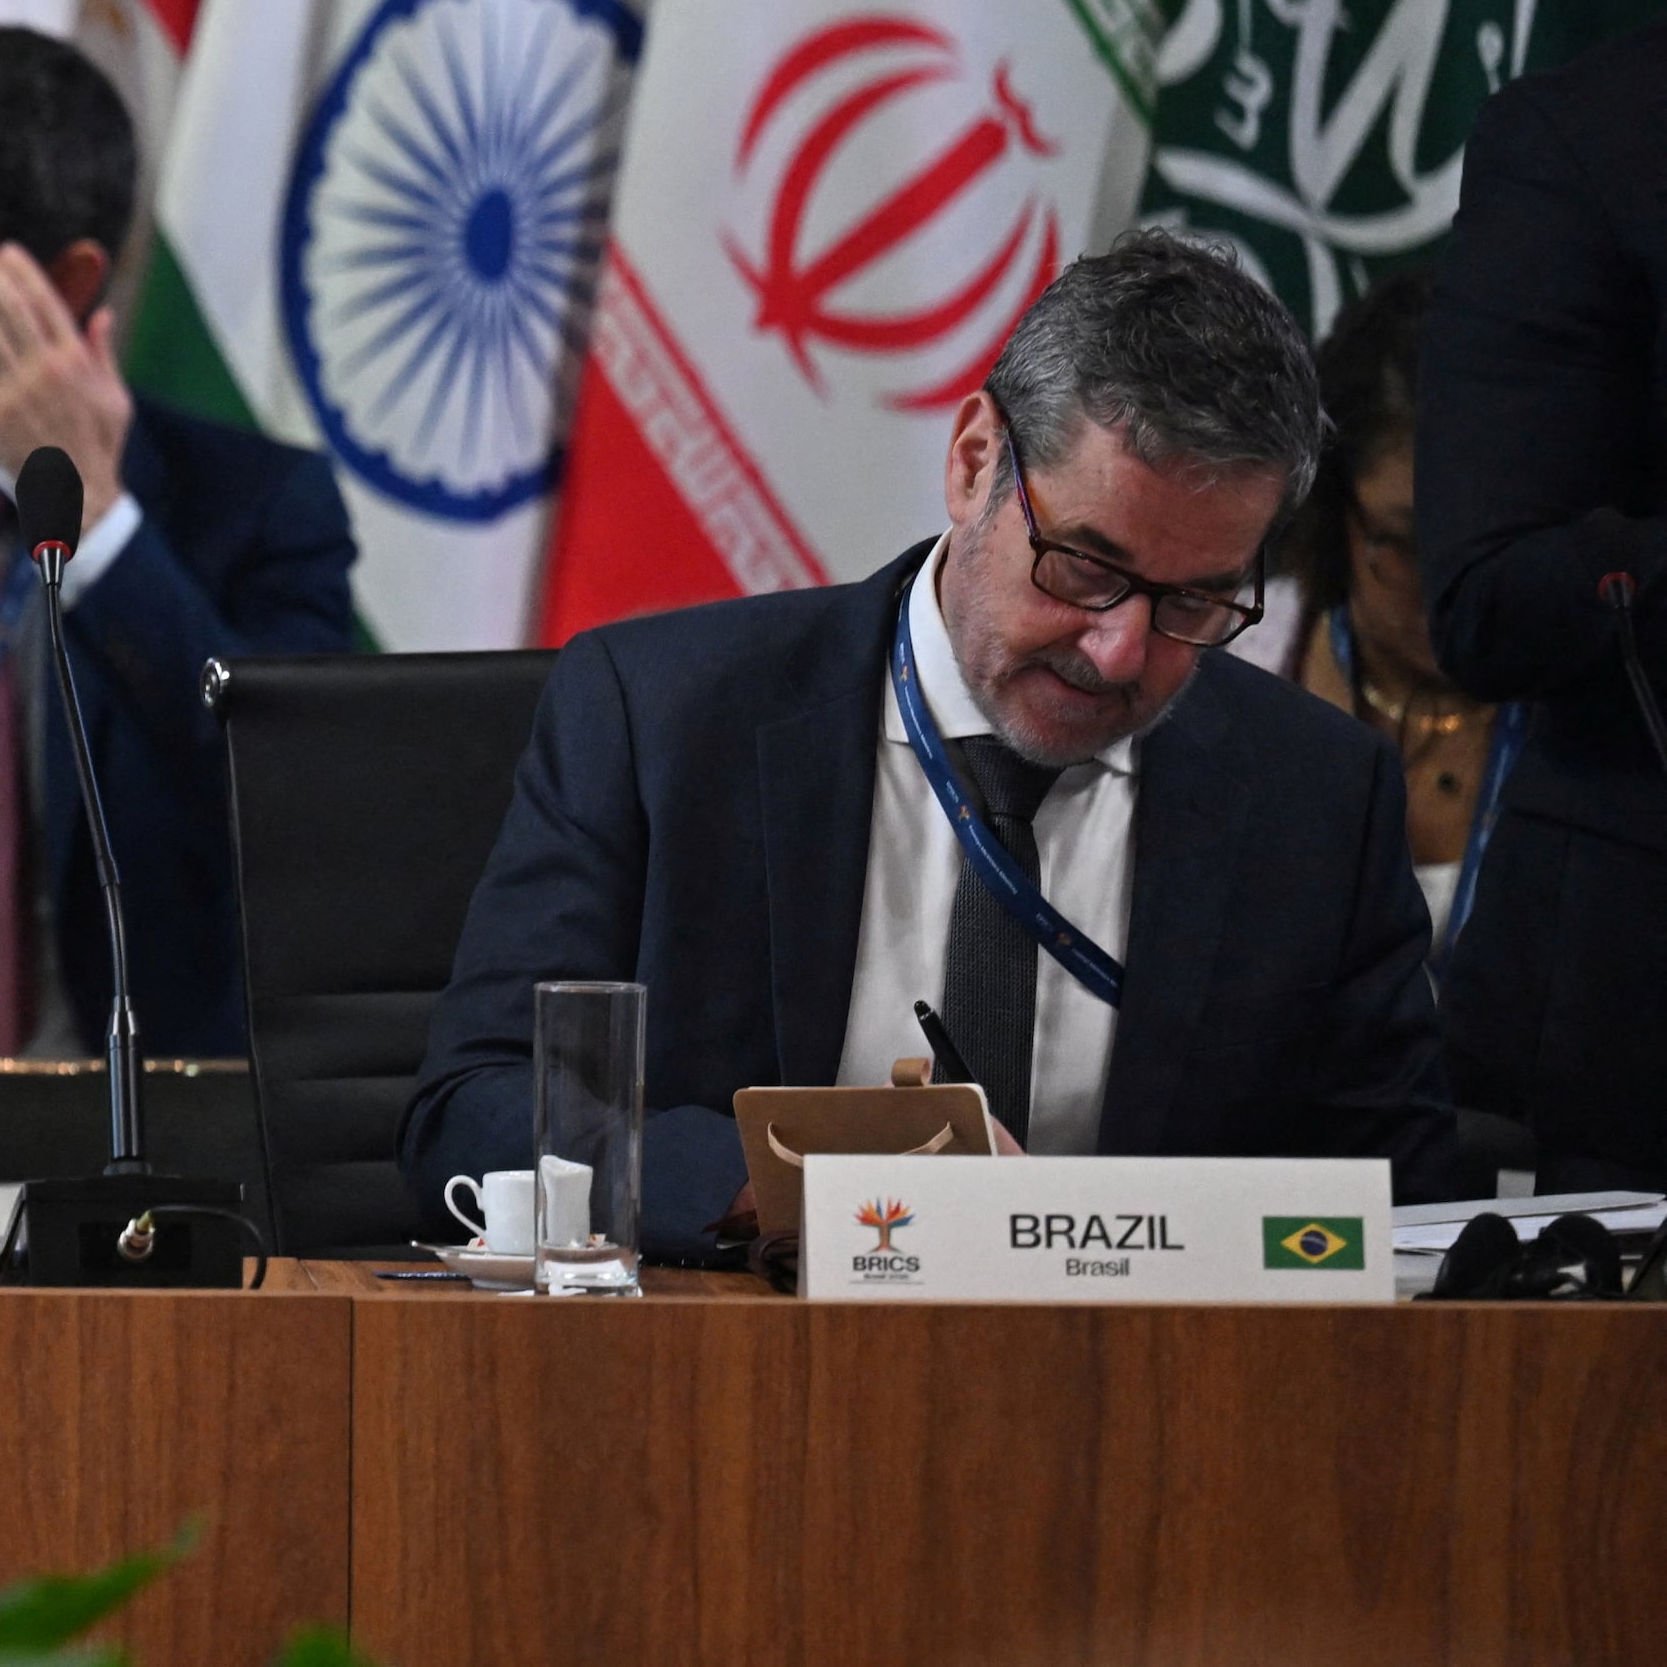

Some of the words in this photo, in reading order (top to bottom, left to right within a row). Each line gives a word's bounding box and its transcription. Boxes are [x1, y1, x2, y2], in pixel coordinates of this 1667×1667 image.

[1009, 1214, 1185, 1251] BRAZIL
[852, 1256, 921, 1273] BRICS
[1065, 1257, 1131, 1277] Brasil
